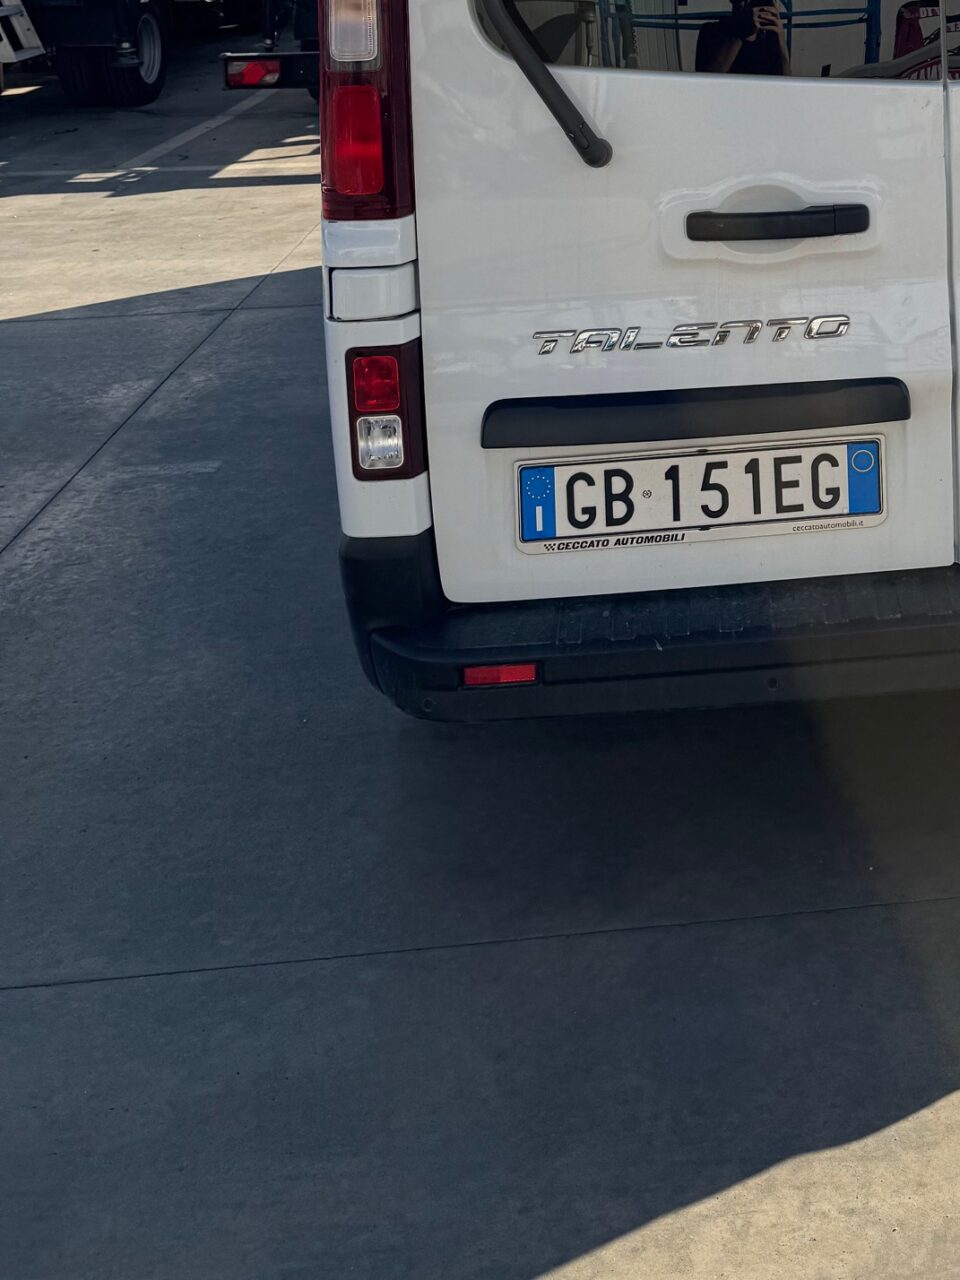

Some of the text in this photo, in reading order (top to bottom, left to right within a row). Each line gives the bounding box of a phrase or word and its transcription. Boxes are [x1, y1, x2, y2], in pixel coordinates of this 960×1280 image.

[532, 314, 851, 356] TALENTO
[792, 519, 865, 532] ceccatoautomobili.it
[556, 532, 686, 552] CECCATO AUTOMOBILI
